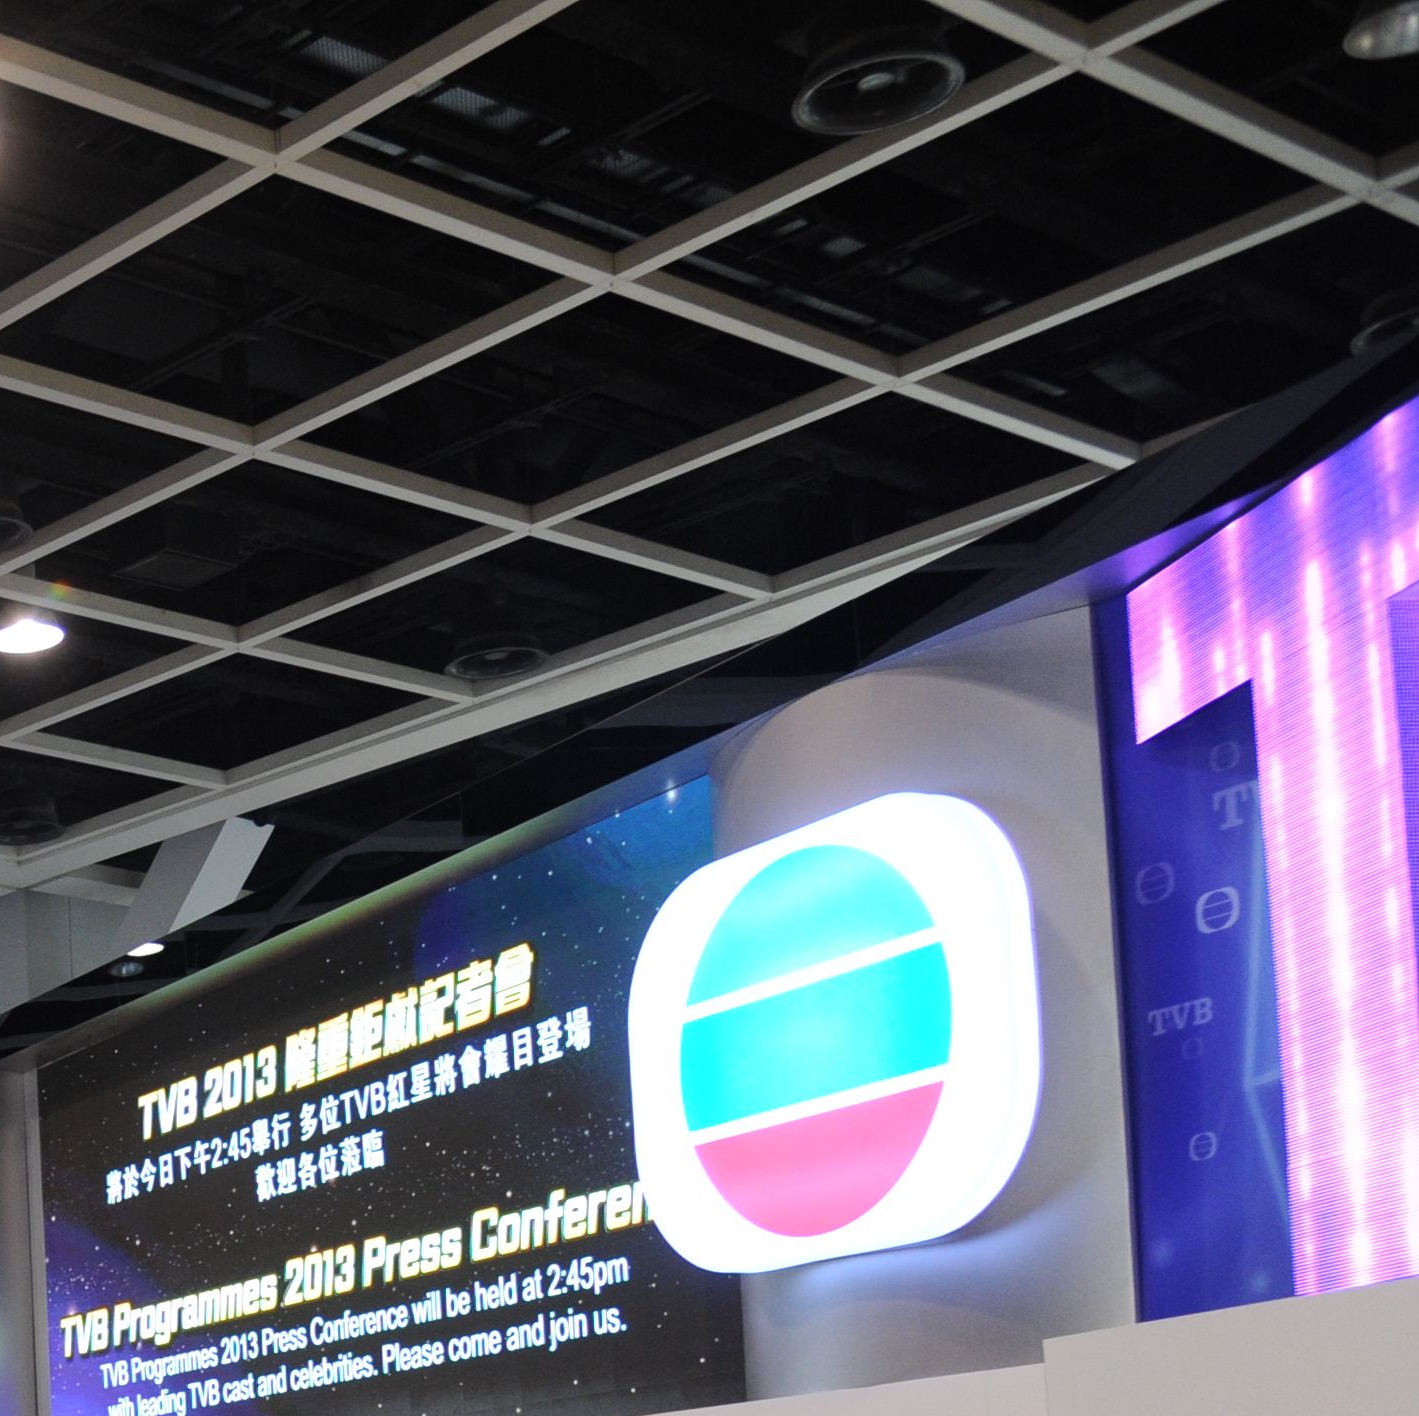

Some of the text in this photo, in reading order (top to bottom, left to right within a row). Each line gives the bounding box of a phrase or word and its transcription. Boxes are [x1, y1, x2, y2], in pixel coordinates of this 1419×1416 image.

[1147, 998, 1213, 1037] TVB
[106, 1006, 592, 1205] 將於今日下午2:45舉行 多位TVB紅星將會耀目登場
[138, 1077, 197, 1140] TVB
[203, 1045, 278, 1117] 2013
[256, 1129, 386, 1203] 歡迎各位蒞臨
[60, 1309, 109, 1359] TVB
[113, 1274, 277, 1346] Programmes
[284, 1244, 356, 1305] 2013
[362, 1228, 462, 1288] Press
[100, 1254, 630, 1390] TVB Programmes 2013 Press Conference will be held at 2:45pm
[188, 1376, 221, 1406] TVB
[223, 1371, 256, 1399] cast
[257, 1364, 287, 1395] and
[290, 1349, 379, 1391] celebrities.
[381, 1335, 445, 1374] Please
[448, 1329, 503, 1363] come
[505, 1316, 545, 1353] and
[548, 1312, 589, 1352] join
[593, 1304, 628, 1335] us.
